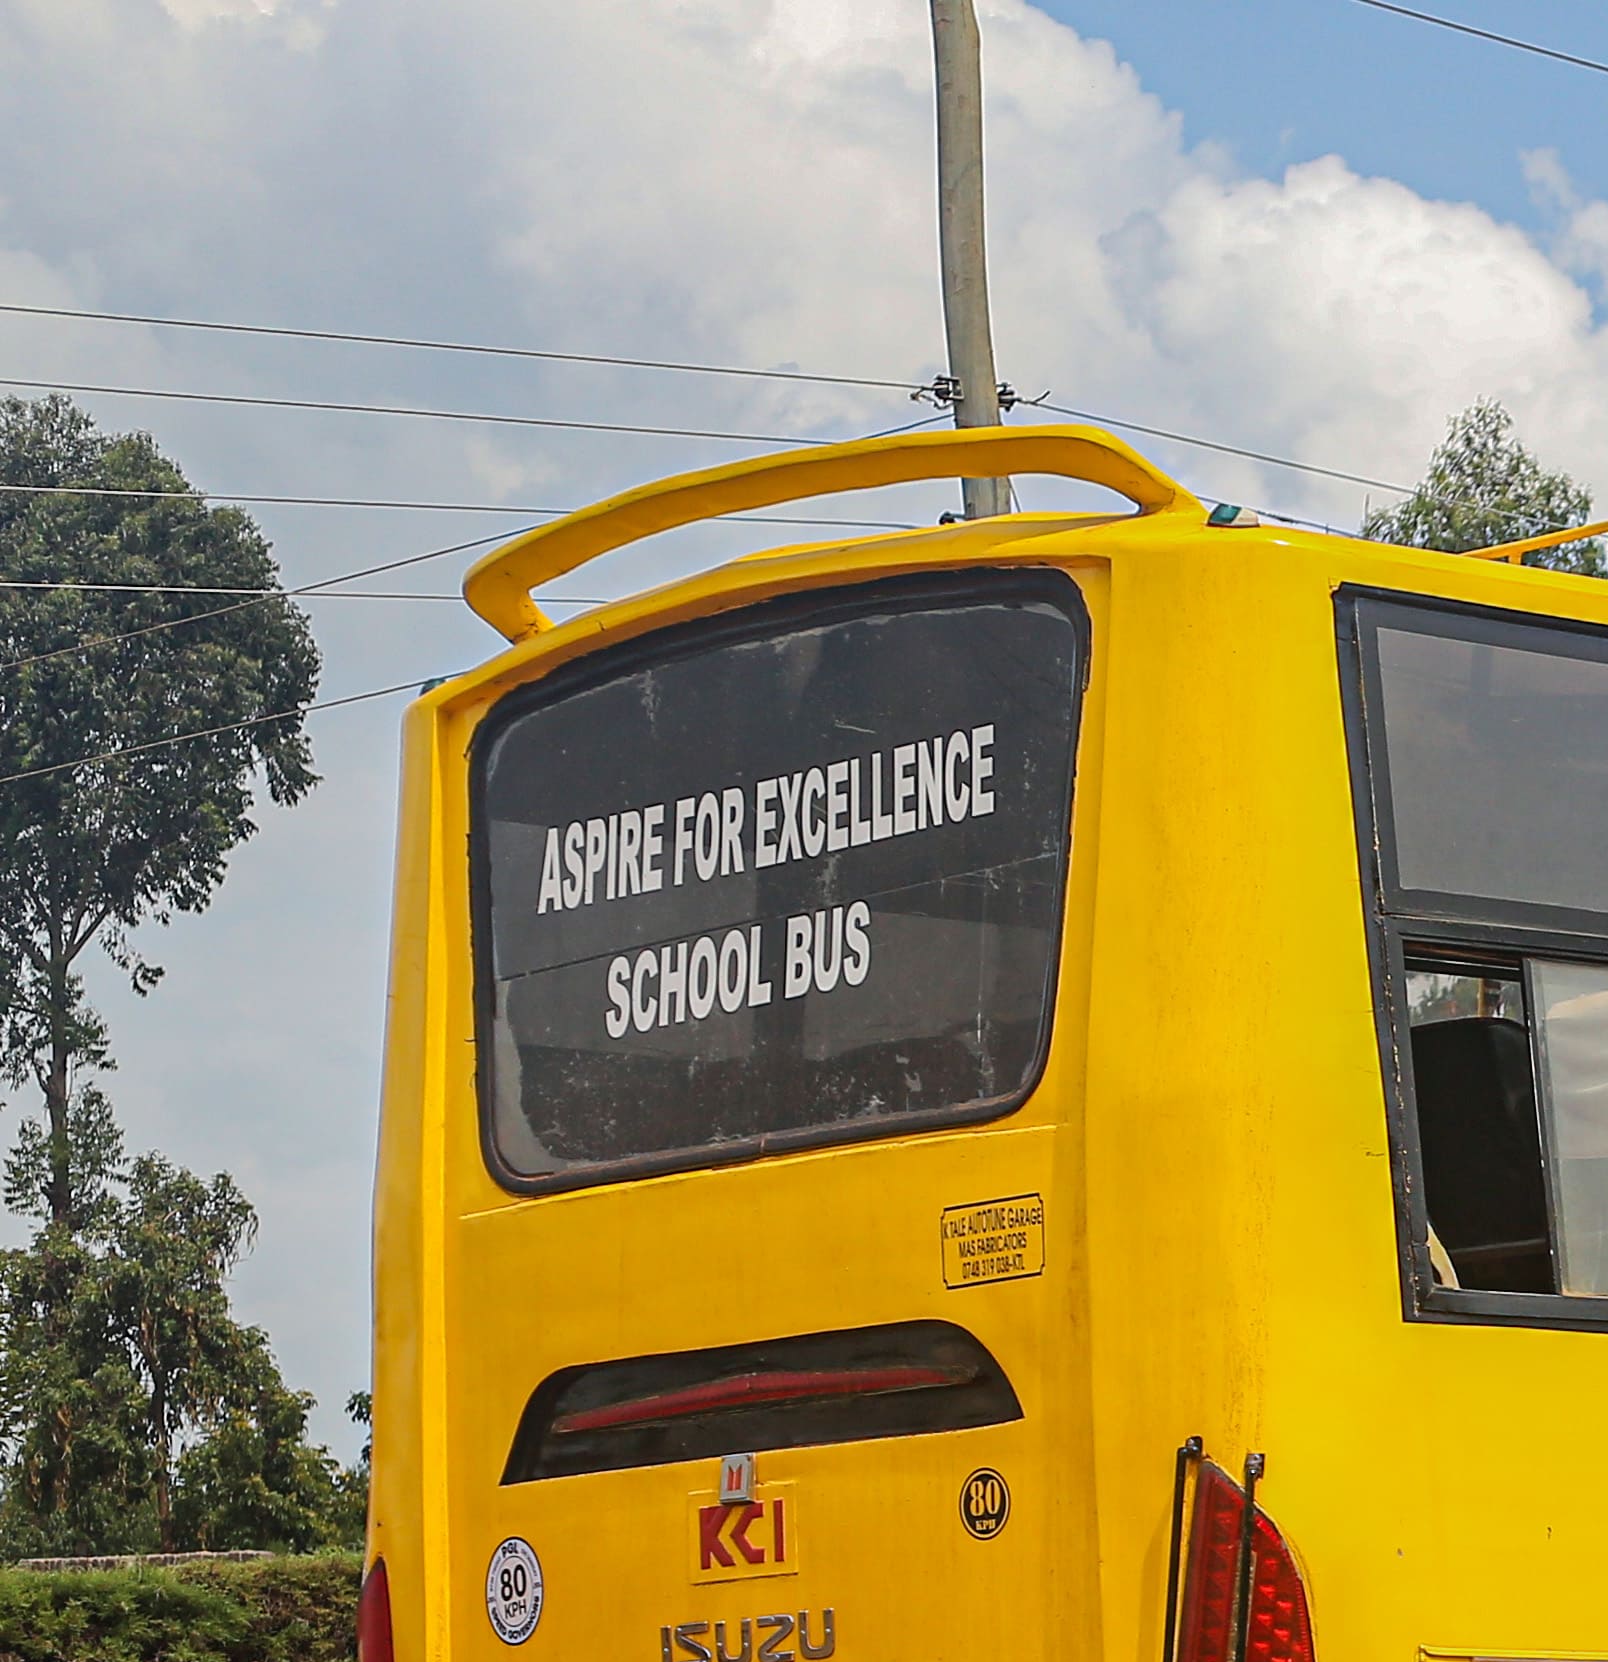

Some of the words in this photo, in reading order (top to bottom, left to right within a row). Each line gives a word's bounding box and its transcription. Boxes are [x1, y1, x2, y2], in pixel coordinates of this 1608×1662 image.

[537, 804, 665, 915] ASPIRE
[673, 787, 745, 887] FOR
[755, 724, 996, 869] EXCELLENCE
[605, 925, 772, 1040] SCHOOL
[784, 900, 872, 1000] BUS
[1007, 1207, 1042, 1229] GARAGE
[977, 1231, 1027, 1256] FABRICATORS
[970, 1479, 1001, 1517] 80
[698, 1497, 785, 1570] KCI
[976, 1518, 996, 1531] KPH
[500, 1563, 527, 1602] 80
[504, 1599, 527, 1619] KPH
